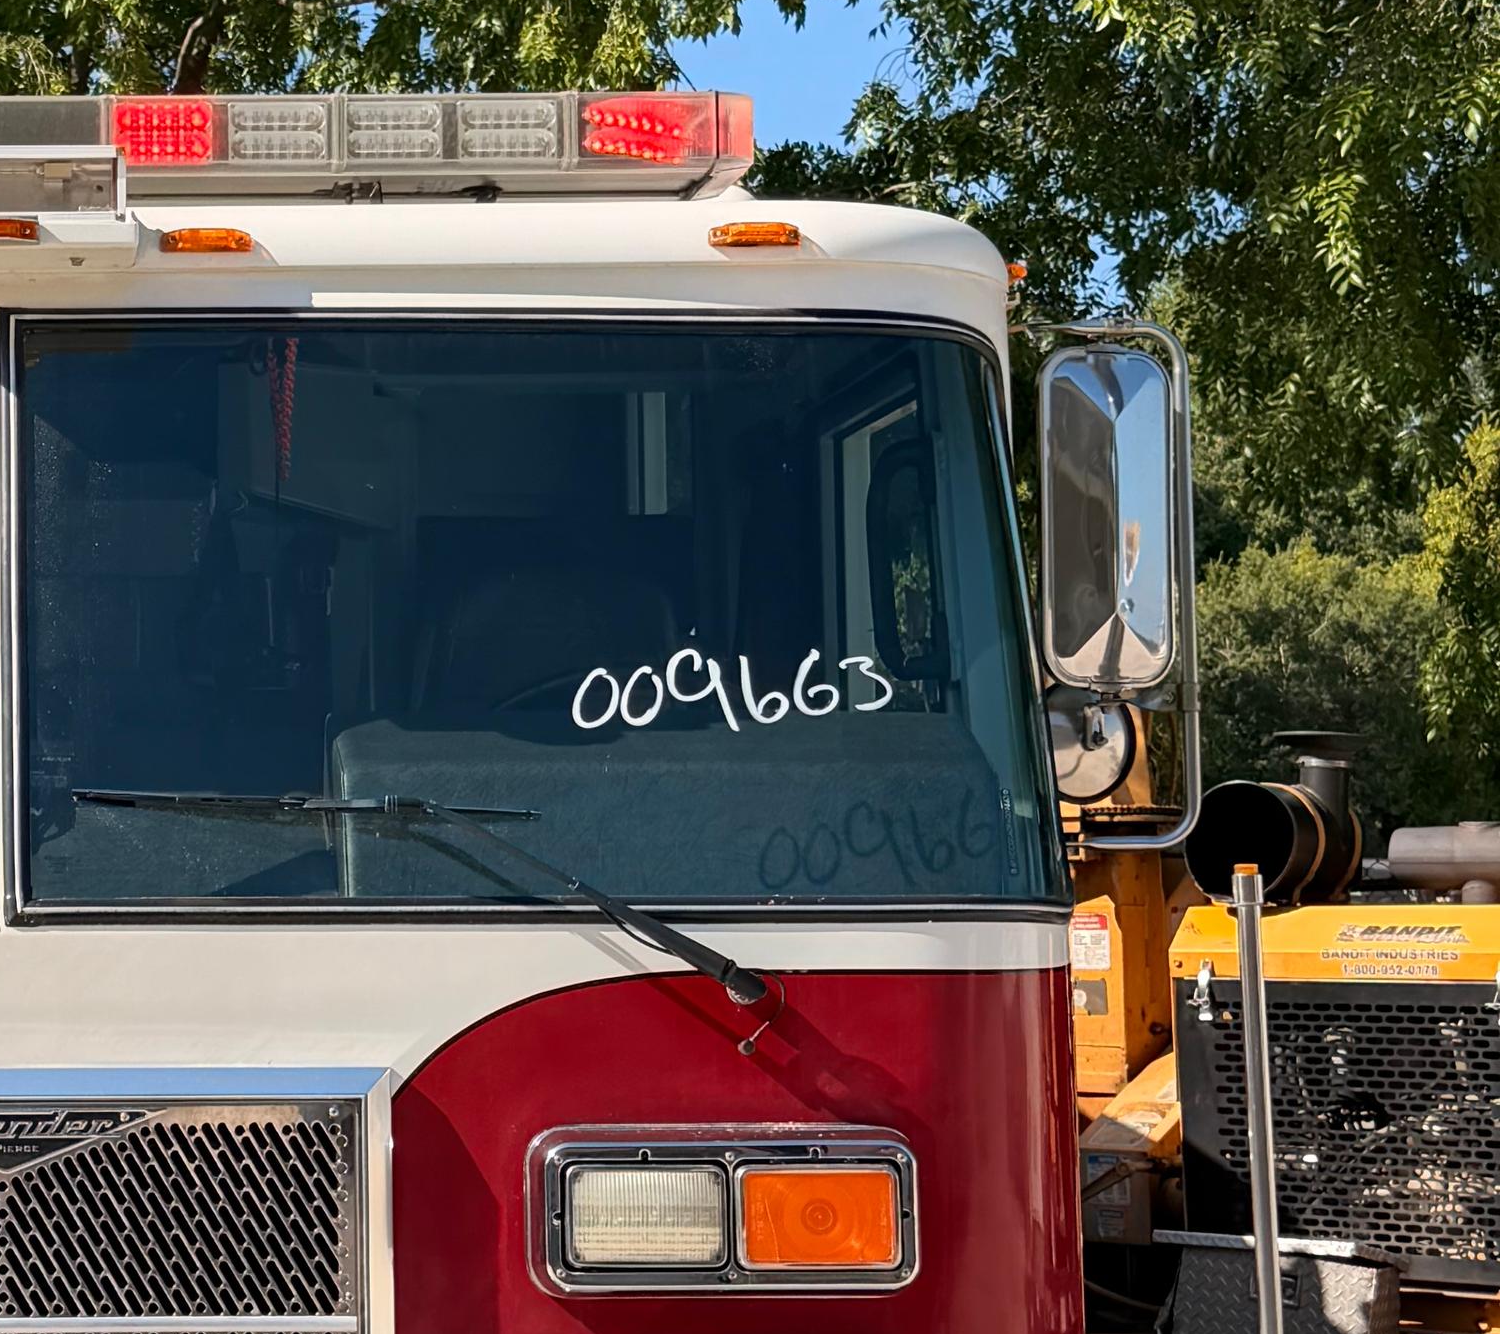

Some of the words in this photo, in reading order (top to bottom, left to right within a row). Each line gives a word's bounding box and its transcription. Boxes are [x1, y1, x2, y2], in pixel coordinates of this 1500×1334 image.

[571, 647, 894, 732] 009663
[1360, 925, 1462, 937] BANDIT
[1321, 949, 1369, 960] BANDIT
[1375, 948, 1459, 960] INDUSTRIES
